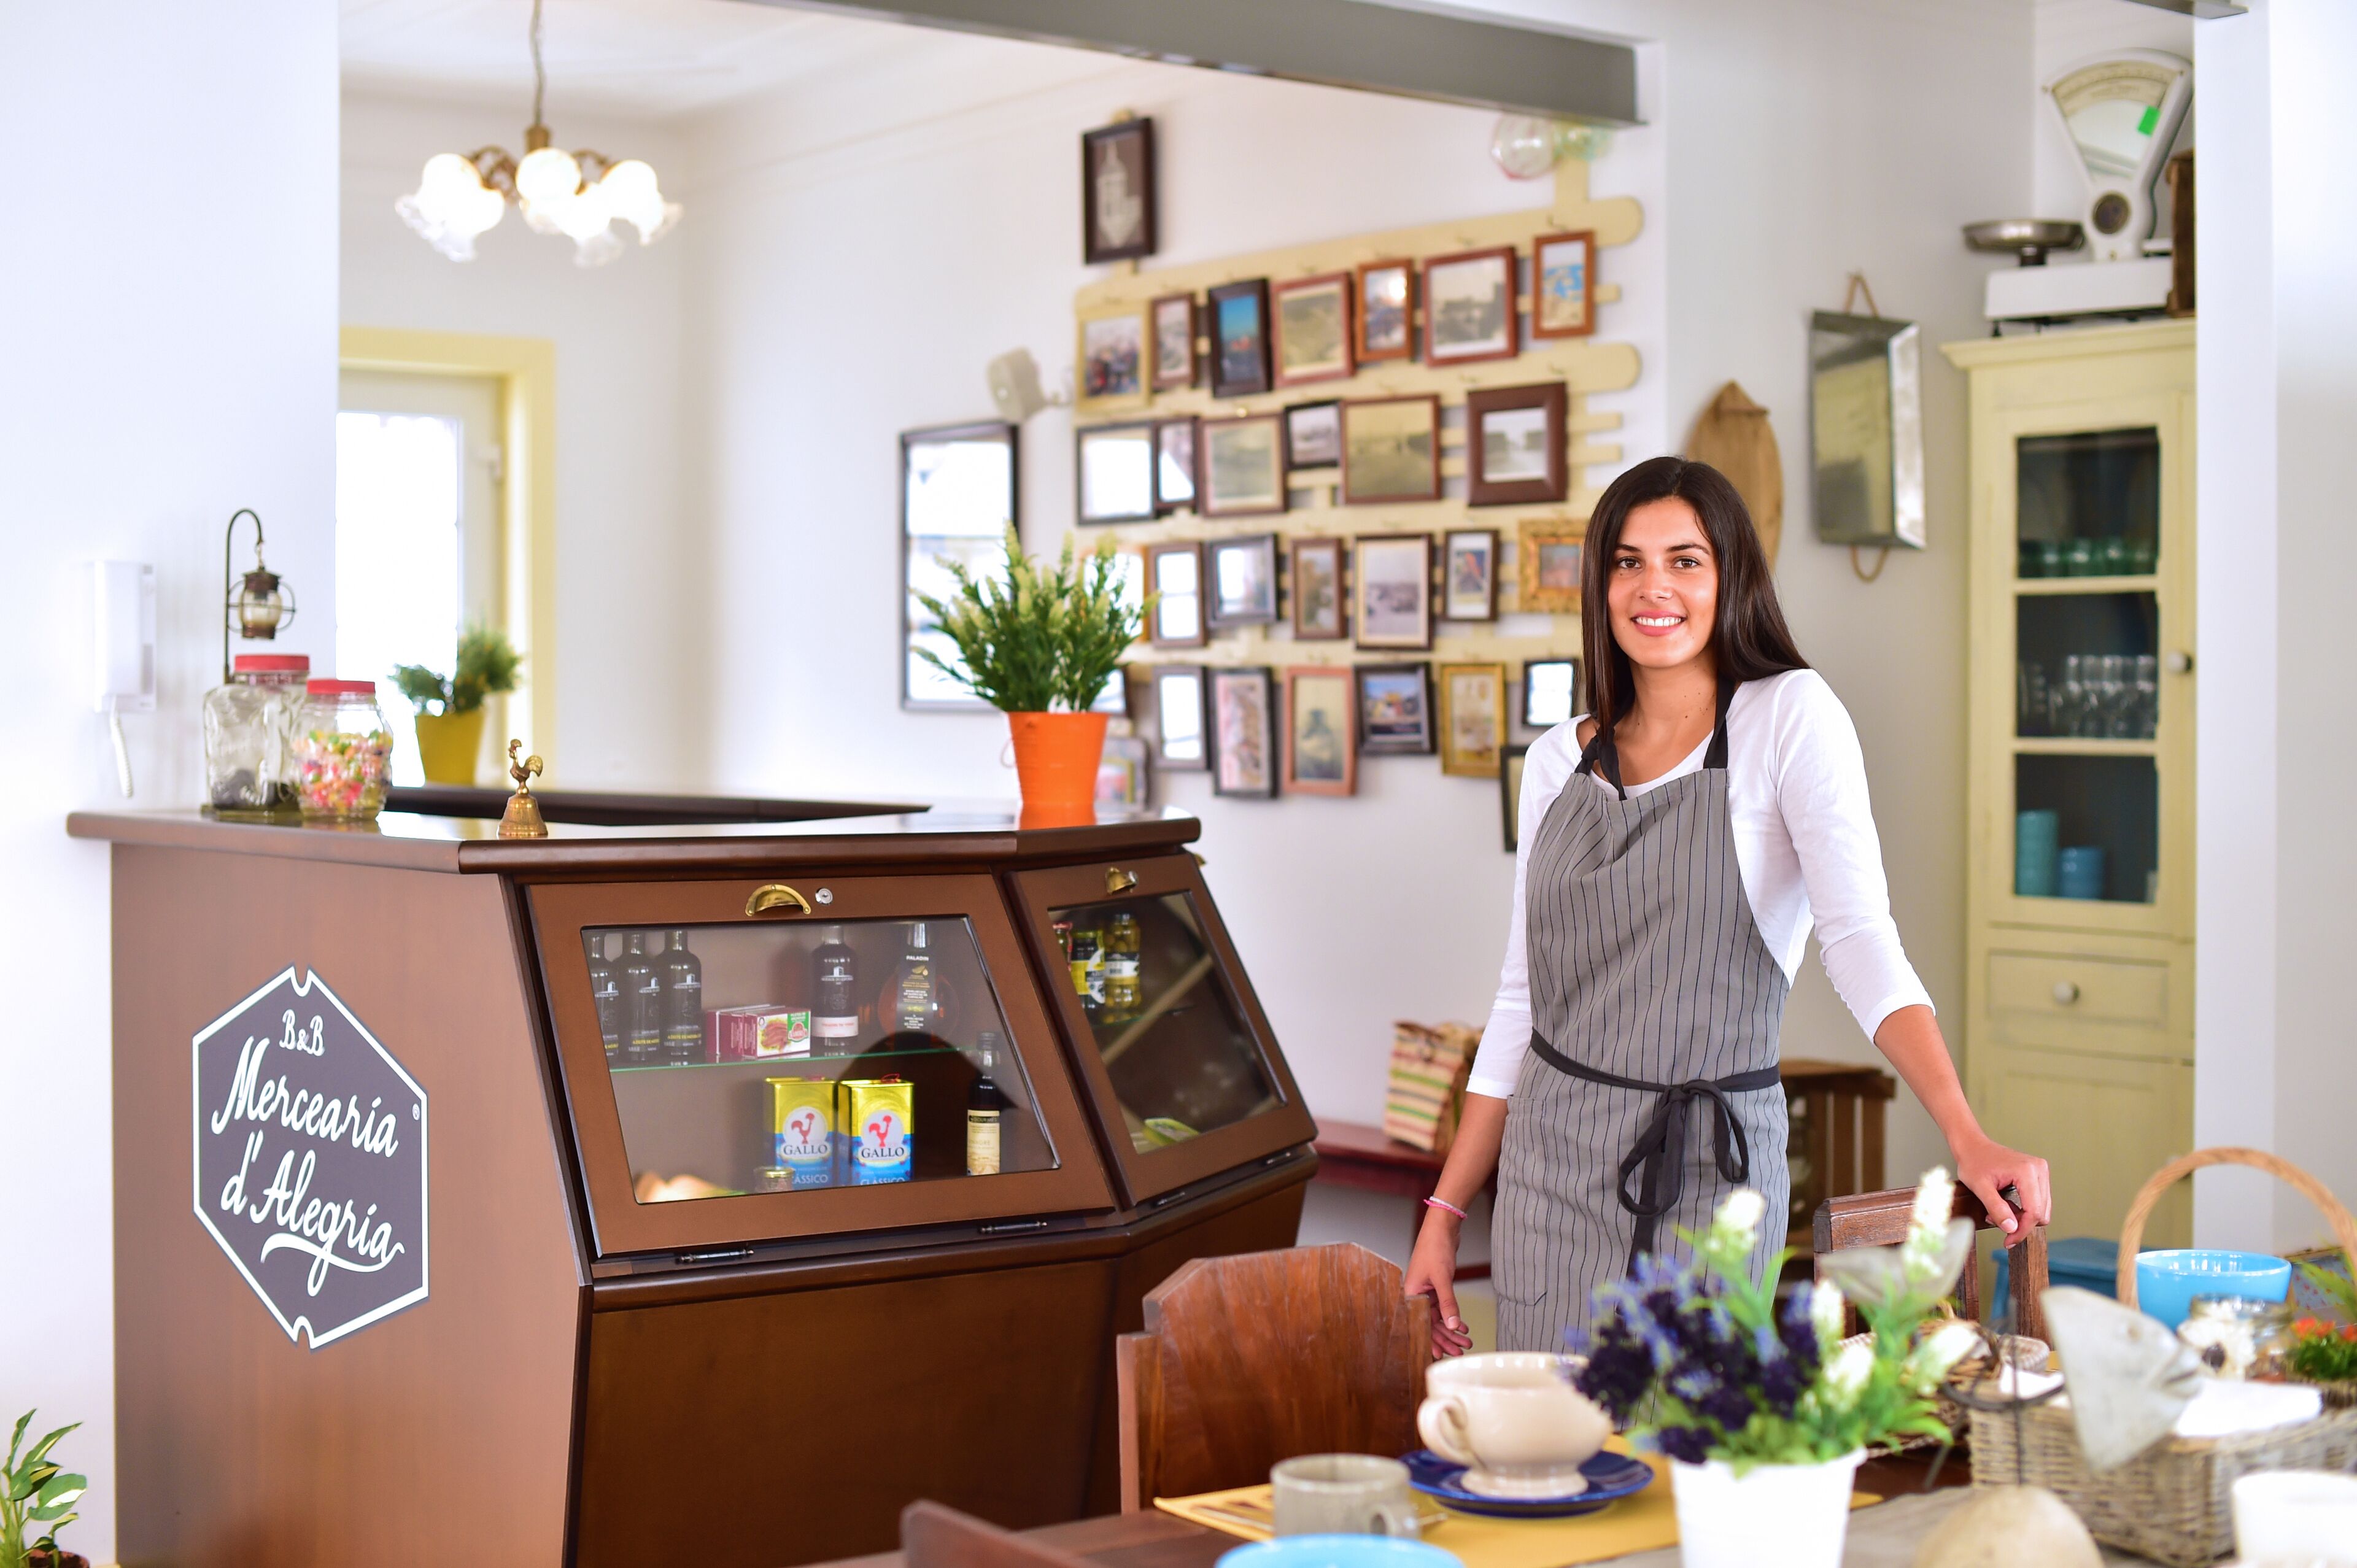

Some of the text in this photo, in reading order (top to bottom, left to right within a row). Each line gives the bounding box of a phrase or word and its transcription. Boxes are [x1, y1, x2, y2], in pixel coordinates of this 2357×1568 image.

[279, 1009, 325, 1056] B&B
[212, 1036, 398, 1157] Mercearia
[783, 1144, 828, 1156] GALLO
[861, 1146, 905, 1159] GALLO
[221, 1129, 405, 1297] d'Alegria
